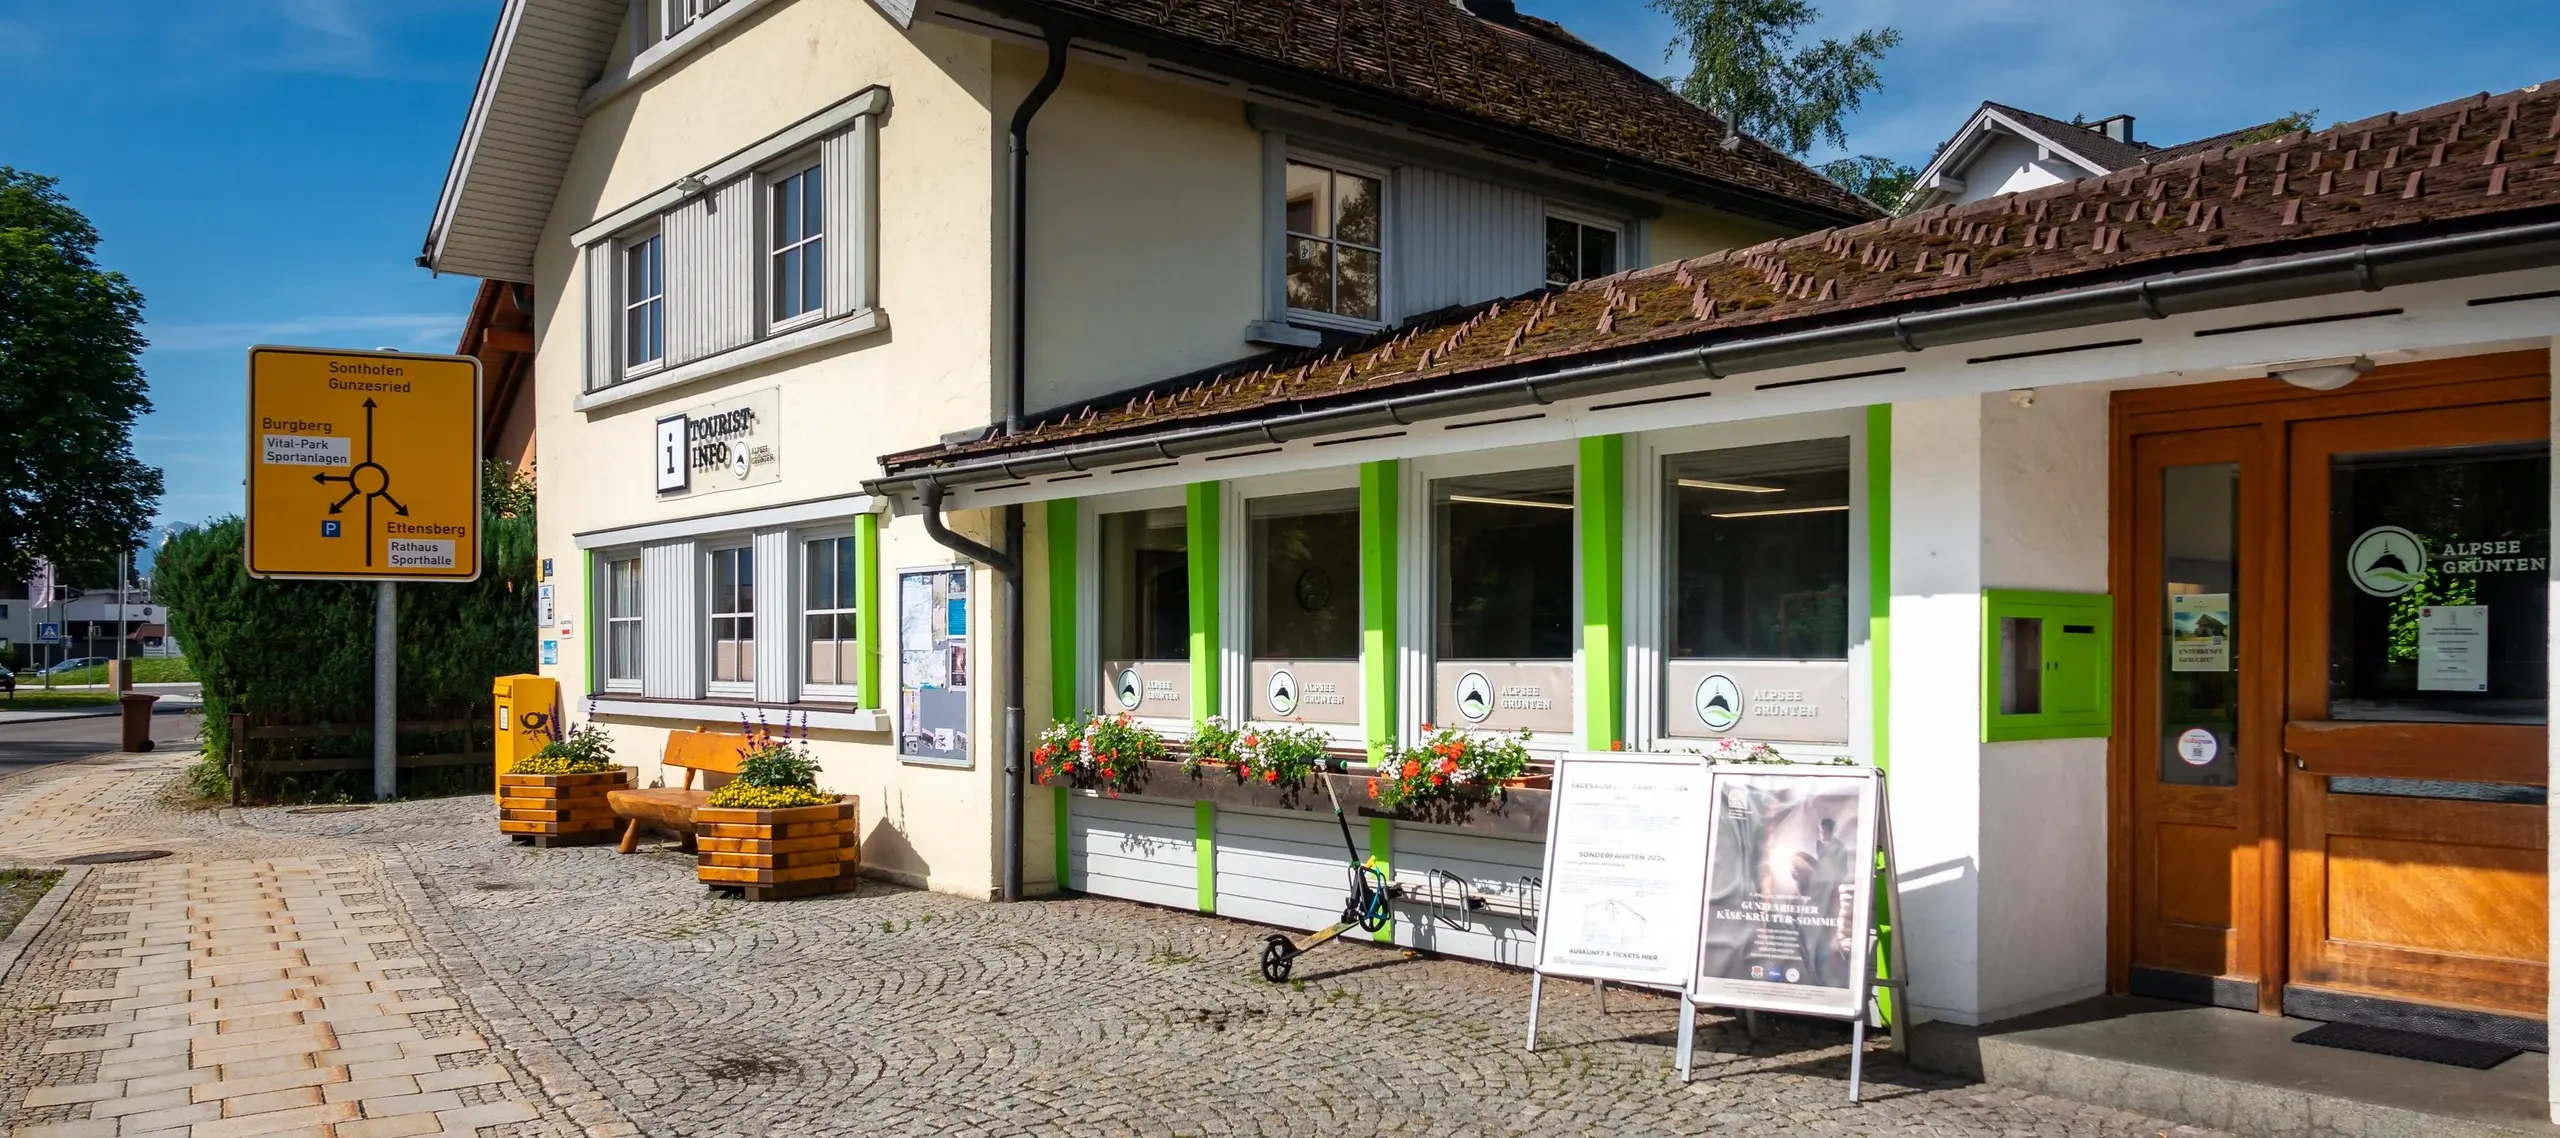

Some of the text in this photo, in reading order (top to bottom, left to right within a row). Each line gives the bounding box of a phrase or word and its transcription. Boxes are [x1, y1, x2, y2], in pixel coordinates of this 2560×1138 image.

[329, 362, 404, 376] Sonthofen
[329, 378, 411, 393] Gunzesried
[262, 418, 332, 434] Burgberg
[267, 438, 328, 450] Vital-Park
[267, 451, 347, 465] Sportanlagen
[692, 441, 727, 469] INFO
[326, 523, 337, 535] P
[387, 522, 466, 537] Ettensberg
[391, 542, 439, 552] Rathaus
[2442, 540, 2521, 556] ALPSEE
[391, 555, 452, 567] Sporthalle
[2442, 557, 2546, 574] GRÜNTEN
[1147, 680, 1173, 691] ALPSEE
[1303, 683, 1336, 694] ALPSEE
[1501, 685, 1541, 697] ALPSEE
[1753, 689, 1803, 702] ALPSEE
[1578, 851, 1645, 861] SONDERFAHRTEN
[1741, 900, 1819, 915] GUNZESRIEDER
[1569, 948, 1604, 957] AUSKUNFT
[1612, 952, 1640, 960] TICKETS
